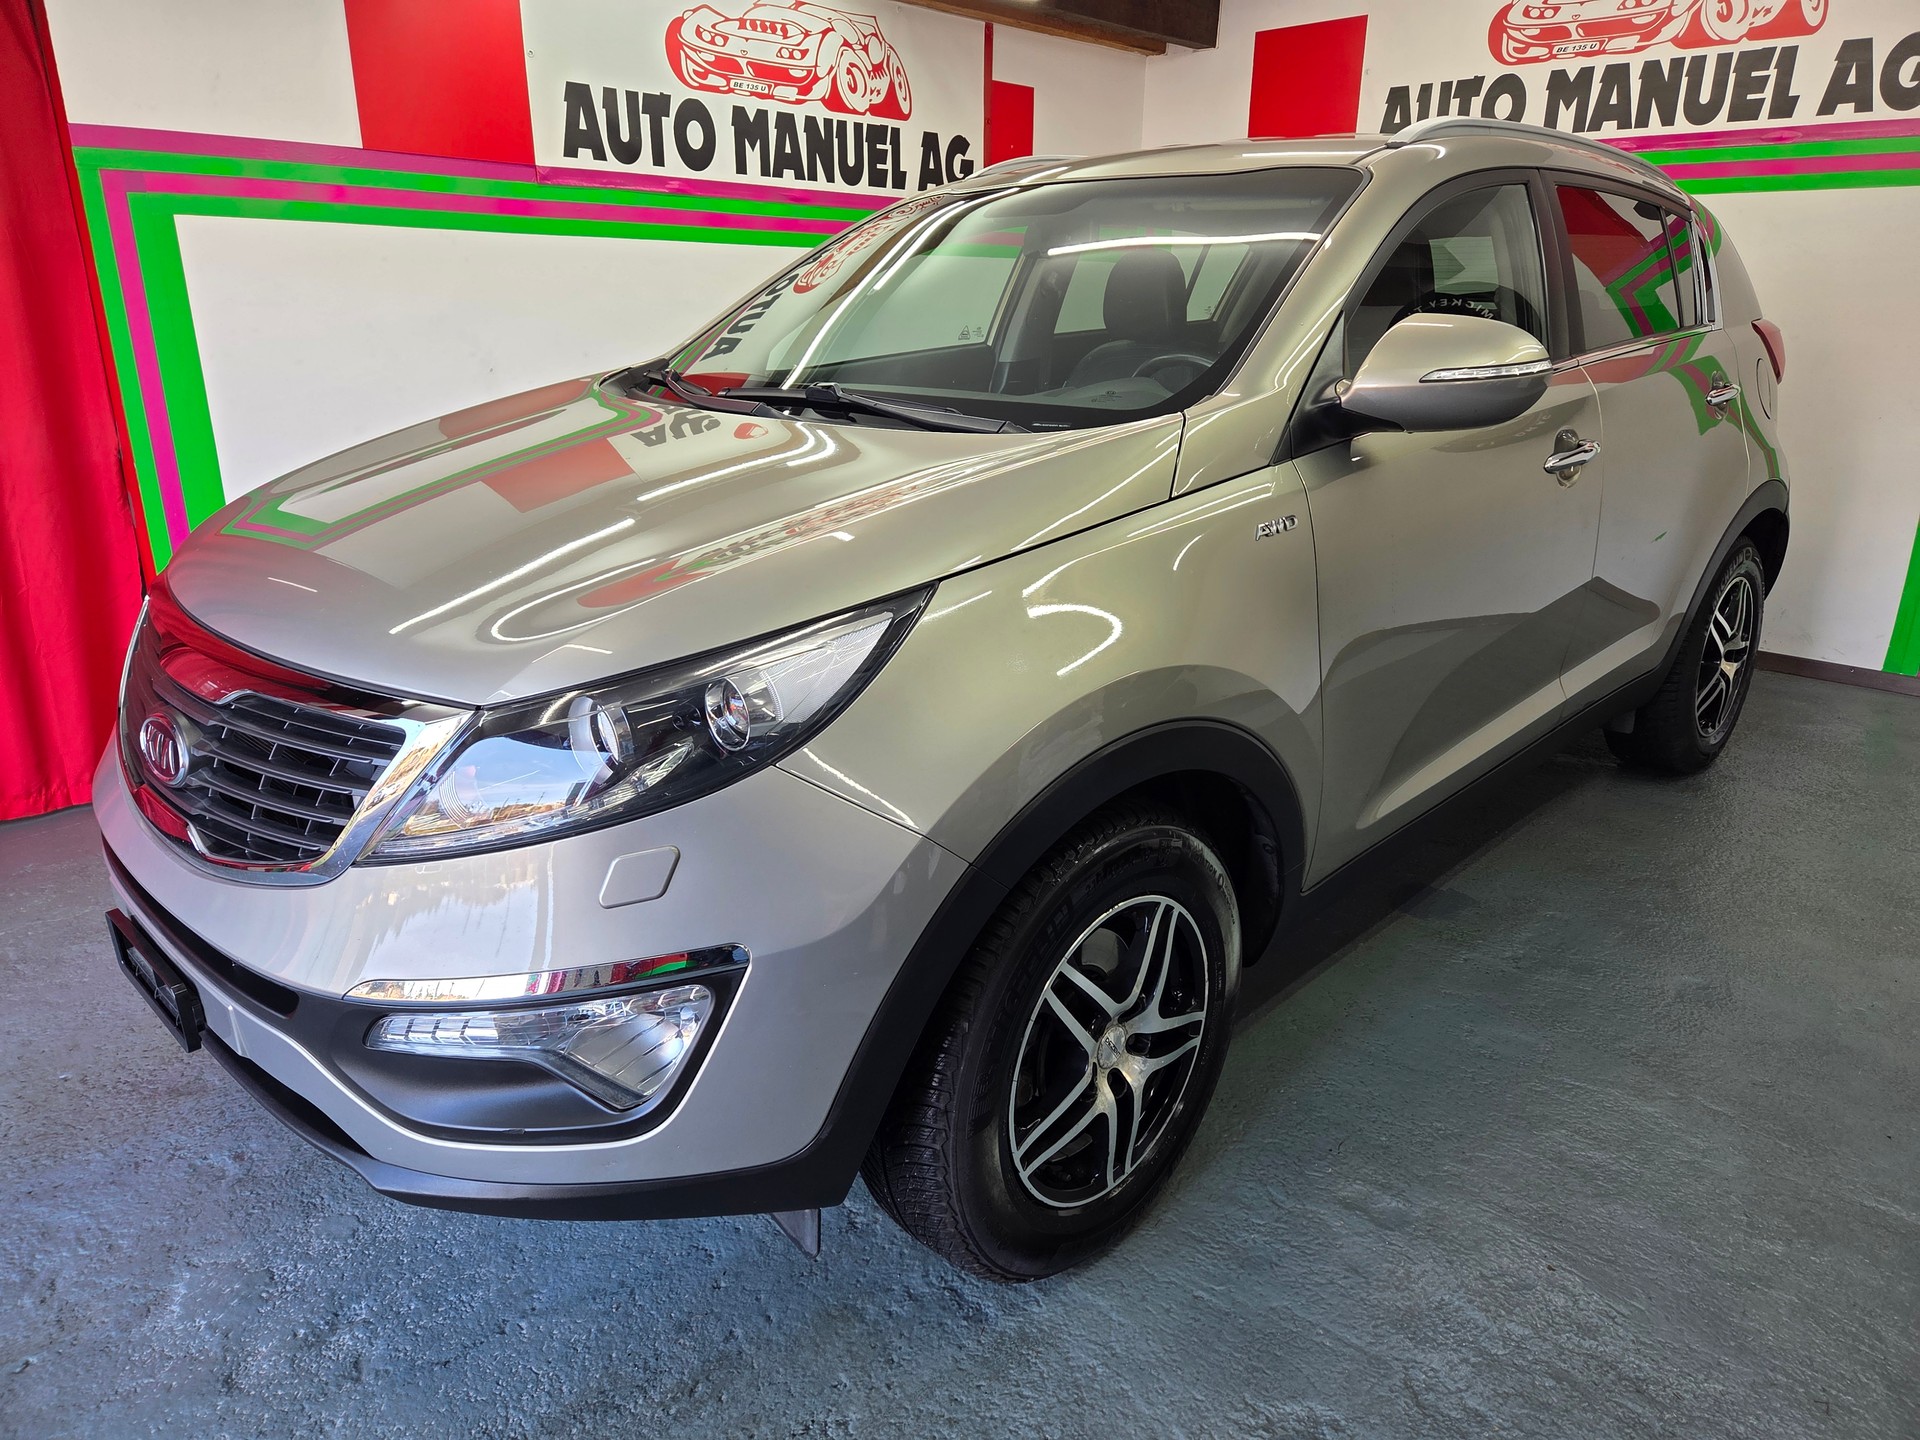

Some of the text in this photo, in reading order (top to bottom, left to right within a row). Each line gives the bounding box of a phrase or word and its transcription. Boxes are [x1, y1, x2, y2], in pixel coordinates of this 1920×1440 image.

[1379, 32, 1920, 134] AUTO MANUEL AG
[563, 82, 975, 191] AUTO MANUEL AG
[1255, 515, 1298, 541] AWD
